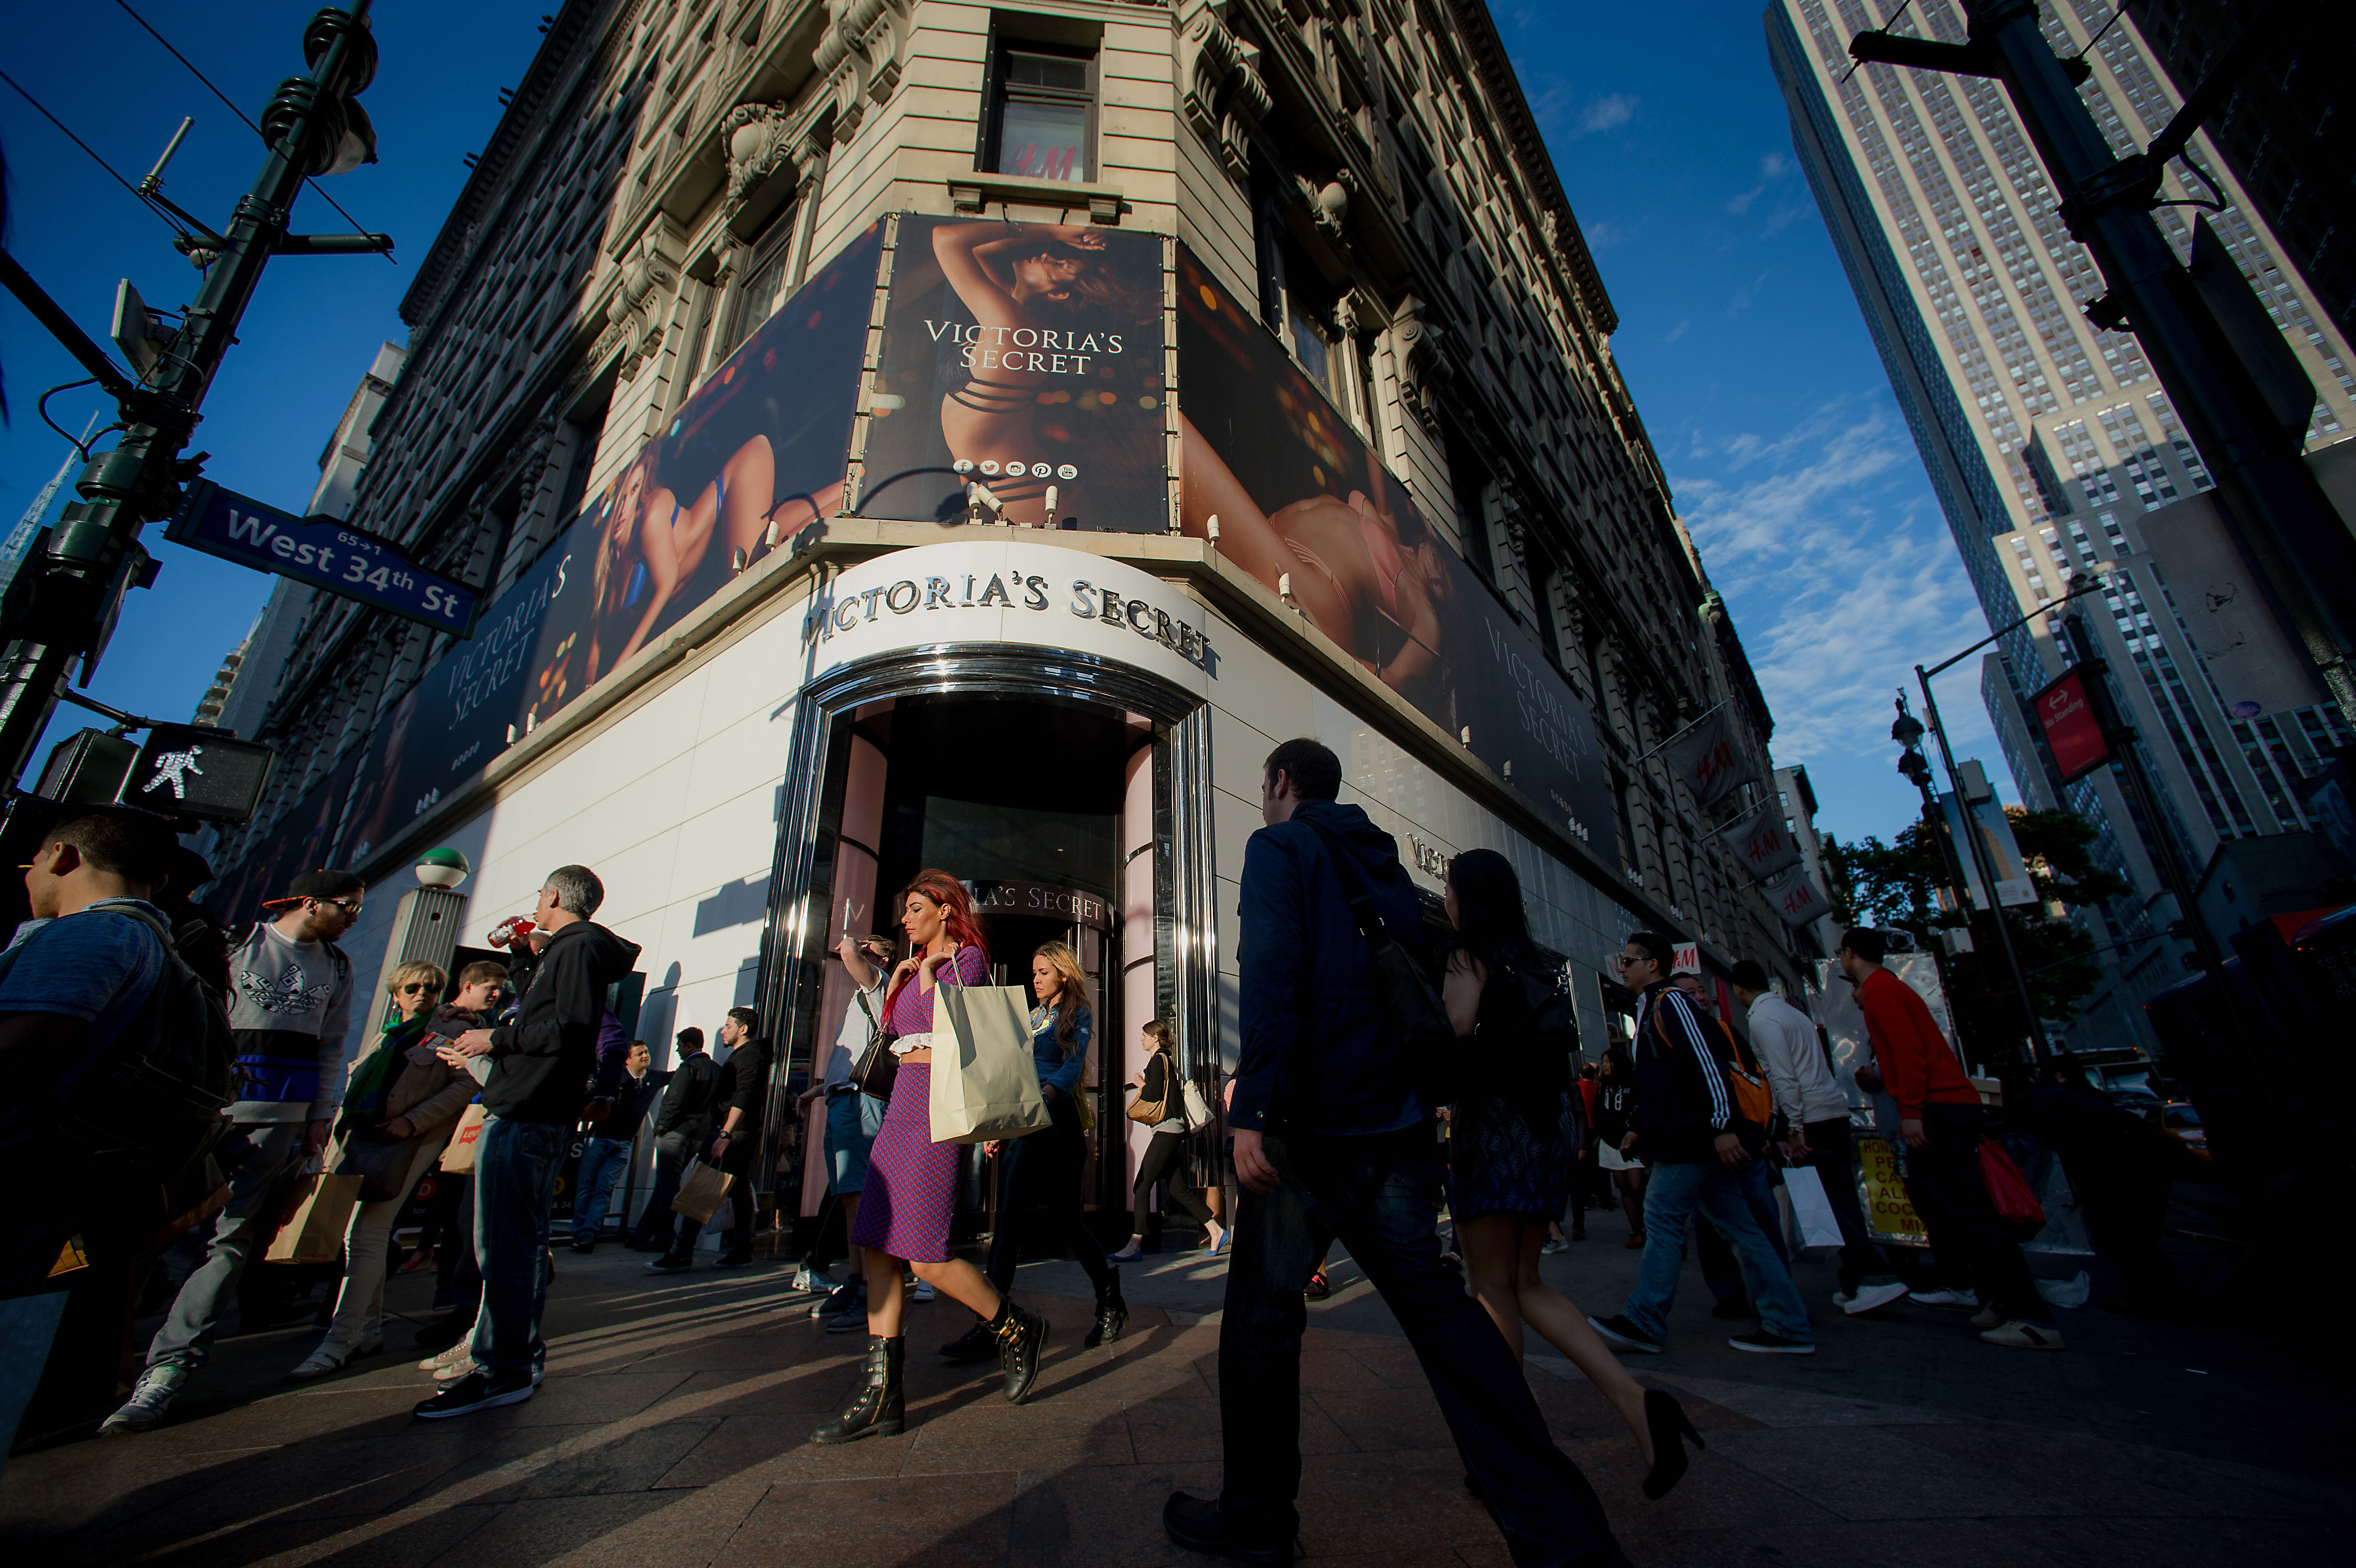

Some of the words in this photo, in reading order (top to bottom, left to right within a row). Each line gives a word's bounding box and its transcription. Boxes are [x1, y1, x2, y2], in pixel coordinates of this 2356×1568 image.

[924, 319, 1123, 354] VICTORIA'S
[960, 346, 1091, 375] SECRET
[228, 508, 335, 573] West
[342, 554, 414, 592] 34th
[421, 585, 458, 618] St
[448, 554, 572, 697] VICTORIA'S
[804, 570, 1048, 646] VICTORIA'S
[1070, 579, 1211, 667] SECRET
[448, 627, 535, 731] SECRET
[1484, 616, 1587, 755] VICTORIA'S
[2044, 718, 2055, 729] No
[2054, 698, 2084, 723] Standing
[1517, 691, 1580, 782] SECRET
[1696, 741, 1735, 787] H&M
[1748, 828, 1781, 866] H&M
[1029, 888, 1101, 921] SECRET
[1783, 884, 1812, 916] H&M
[1864, 1141, 1888, 1153] HON
[1876, 1157, 1896, 1168] PE
[1876, 1172, 1900, 1183] CA
[1876, 1202, 1913, 1215] COC
